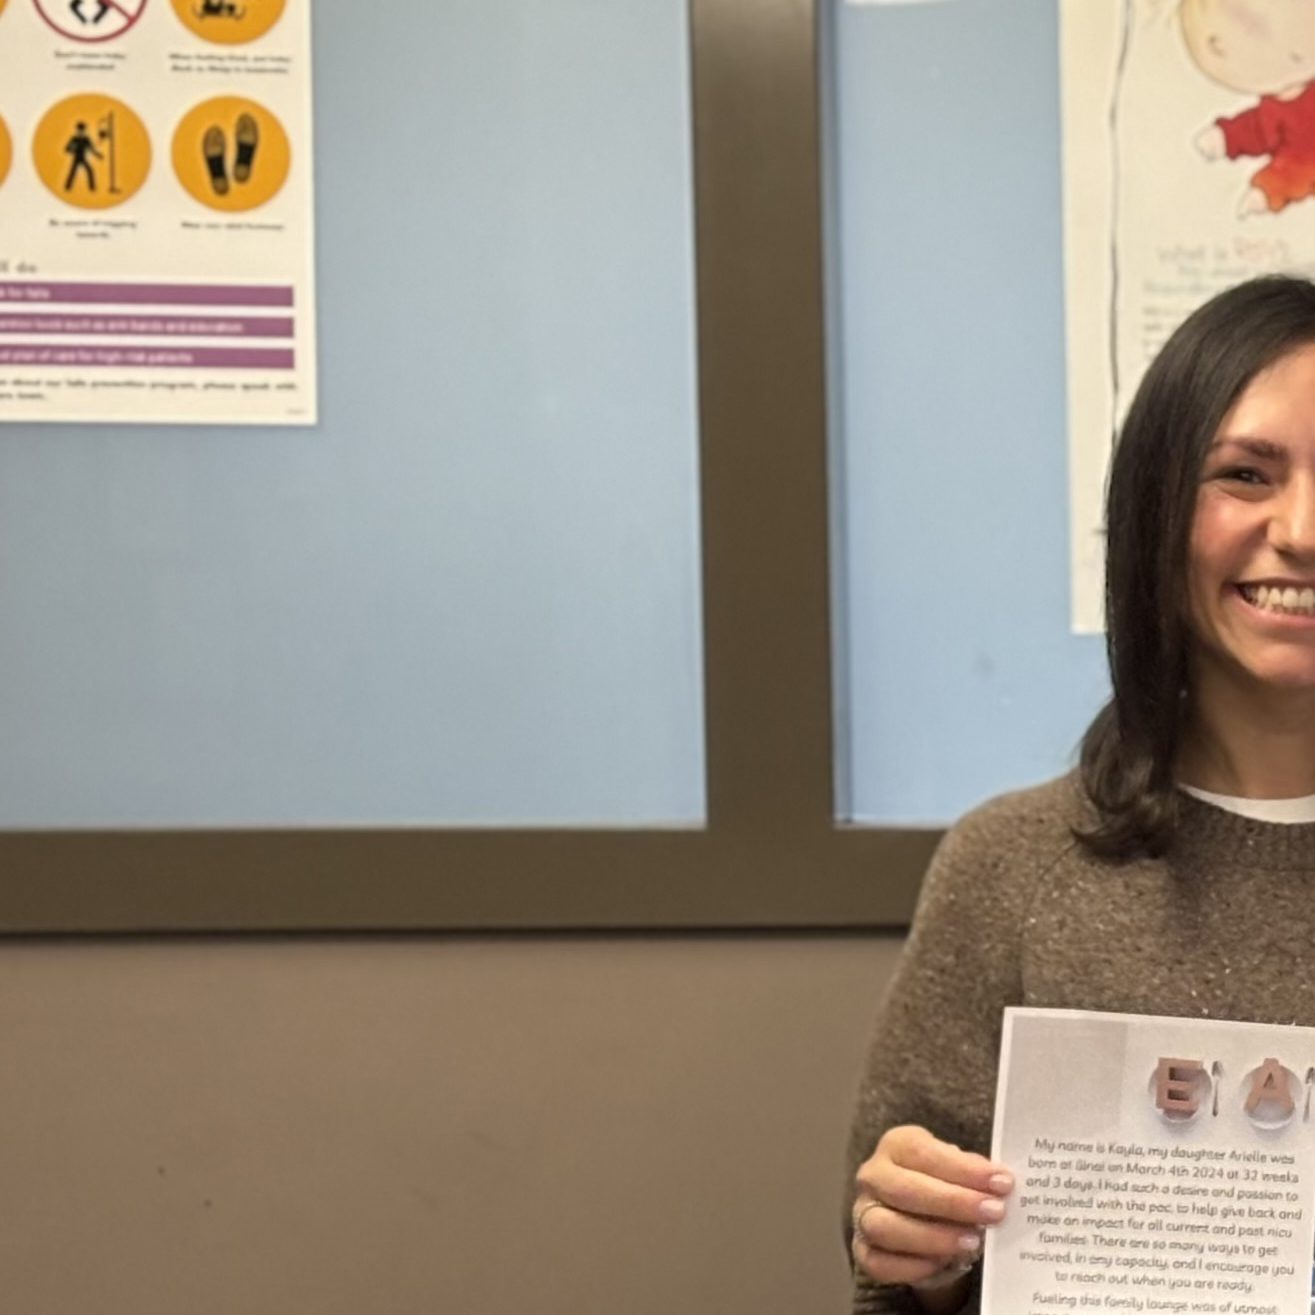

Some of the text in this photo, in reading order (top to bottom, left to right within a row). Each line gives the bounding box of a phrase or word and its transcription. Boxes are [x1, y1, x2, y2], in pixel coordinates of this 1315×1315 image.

[1033, 1137, 1055, 1154] My
[1056, 1141, 1093, 1153] name
[1146, 1146, 1168, 1161] my
[1169, 1145, 1226, 1162] daughter
[1227, 1149, 1267, 1164] Arielle
[1269, 1154, 1295, 1165] was
[1027, 1154, 1057, 1170] born
[1058, 1159, 1072, 1171] at
[1124, 1162, 1166, 1176] March
[1191, 1165, 1224, 1179] 2024
[1225, 1169, 1240, 1181] at
[1241, 1168, 1258, 1182] 32
[1024, 1174, 1050, 1188] and
[1051, 1175, 1061, 1189] 3
[1103, 1179, 1129, 1193] had
[1159, 1184, 1170, 1195] a
[1171, 1184, 1209, 1197] desire
[1210, 1185, 1235, 1199] and
[1235, 1189, 1283, 1201] passion
[1019, 1195, 1040, 1208] get
[1042, 1194, 1093, 1209] involved
[1095, 1198, 1123, 1211] with
[1124, 1198, 1146, 1212] the
[1190, 1201, 1218, 1217] help
[1219, 1205, 1245, 1220] give
[1246, 1205, 1276, 1220] back
[1277, 1208, 1302, 1221] and
